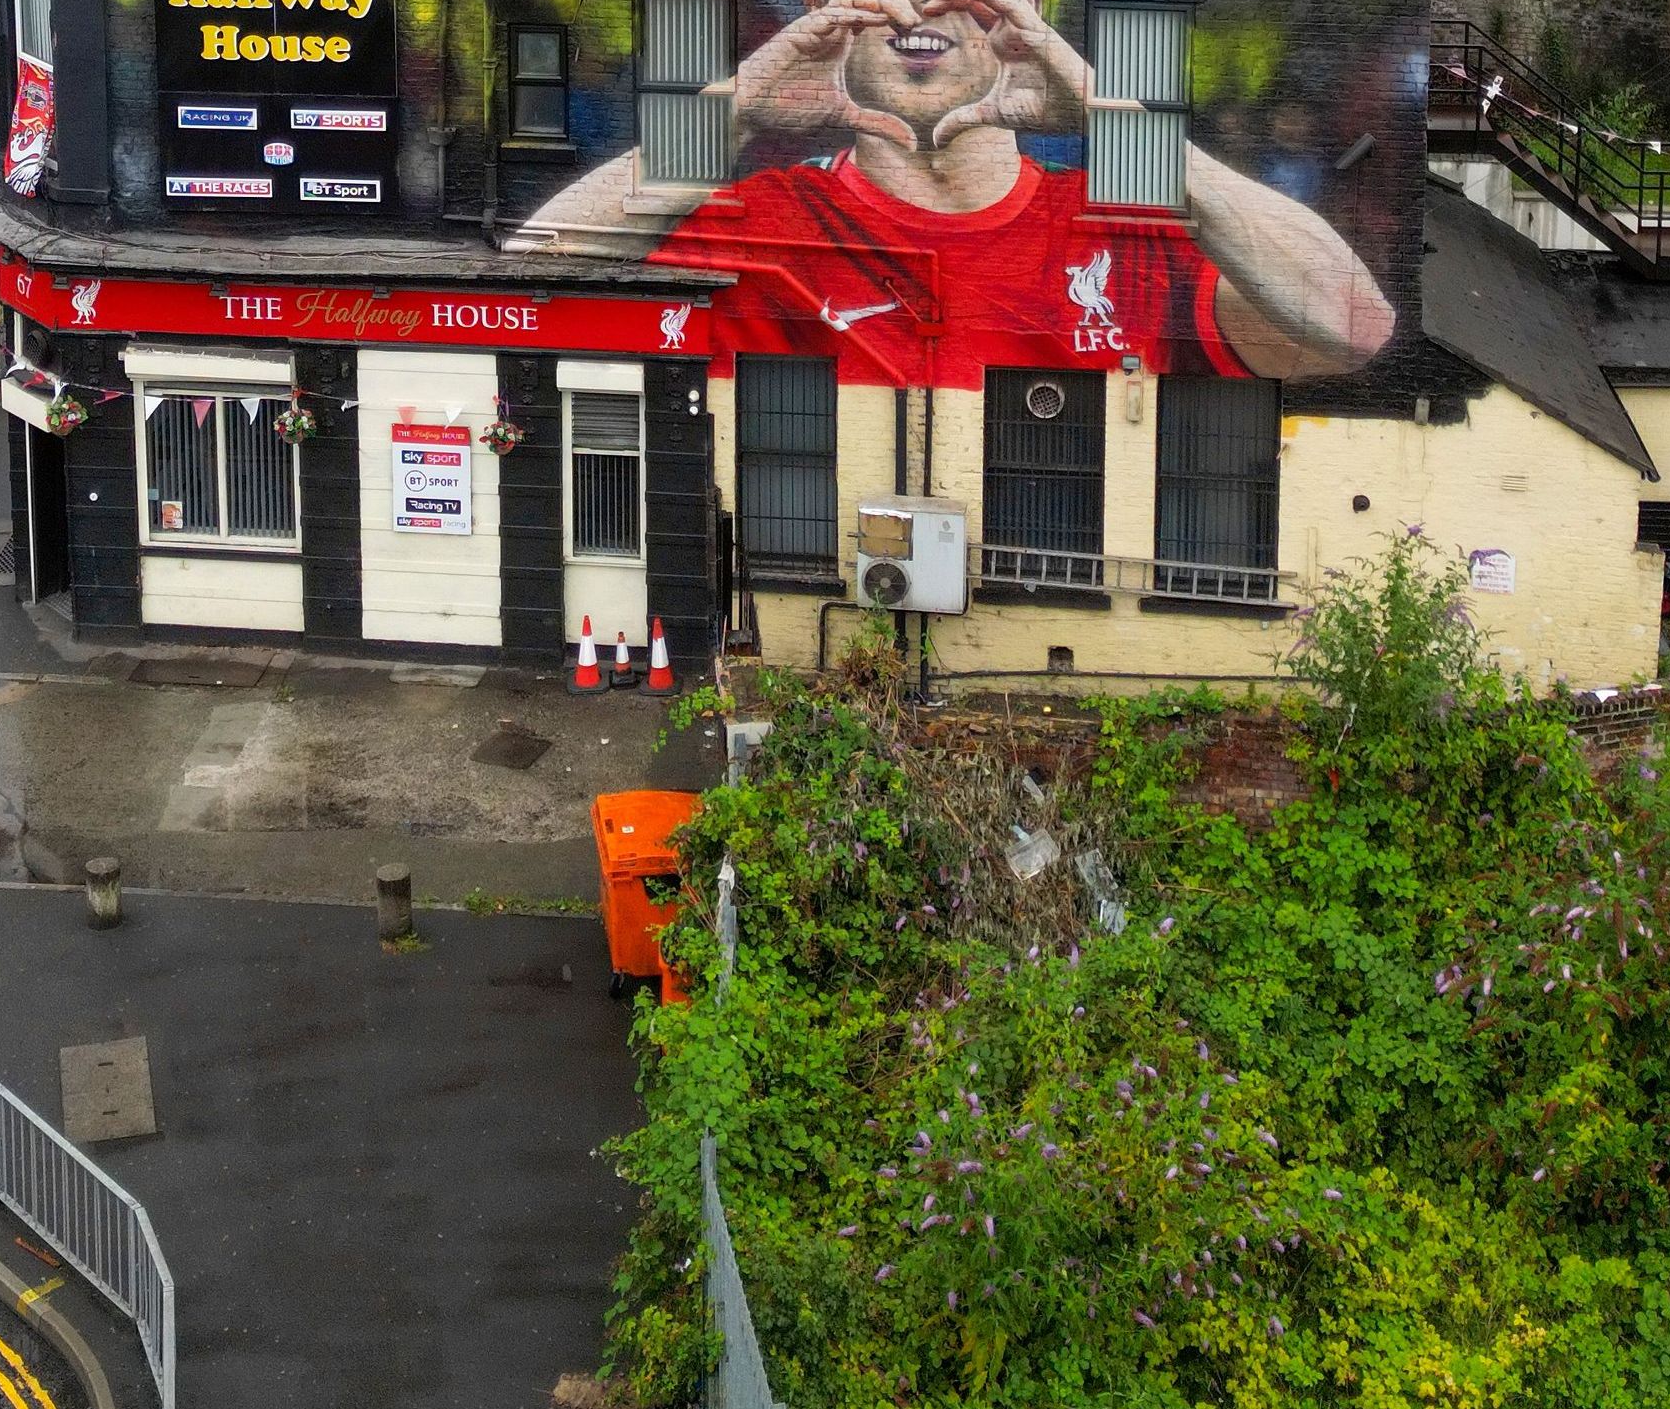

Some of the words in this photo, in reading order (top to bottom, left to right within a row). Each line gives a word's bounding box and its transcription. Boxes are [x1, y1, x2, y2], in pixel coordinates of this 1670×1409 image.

[200, 25, 351, 63] House
[184, 113, 231, 122] RACING
[296, 114, 318, 127] sky
[322, 114, 381, 127] SPORTS
[266, 145, 292, 156] BOX
[171, 181, 189, 192] AT
[193, 181, 222, 193] THE
[222, 182, 269, 194] RACES
[312, 185, 332, 195] BT
[333, 185, 369, 197] Sport
[17, 273, 32, 299] 67
[219, 296, 283, 320] THE
[291, 290, 423, 337] Halfway
[432, 303, 540, 330] HOUSE
[404, 452, 423, 463] sky
[427, 454, 459, 465] sport
[410, 476, 422, 485] BT
[429, 478, 459, 487] SPORT
[409, 500, 443, 512] Racing
[445, 502, 458, 511] TV
[398, 518, 412, 526] sky
[414, 519, 440, 527] sports
[444, 520, 466, 529] racing
